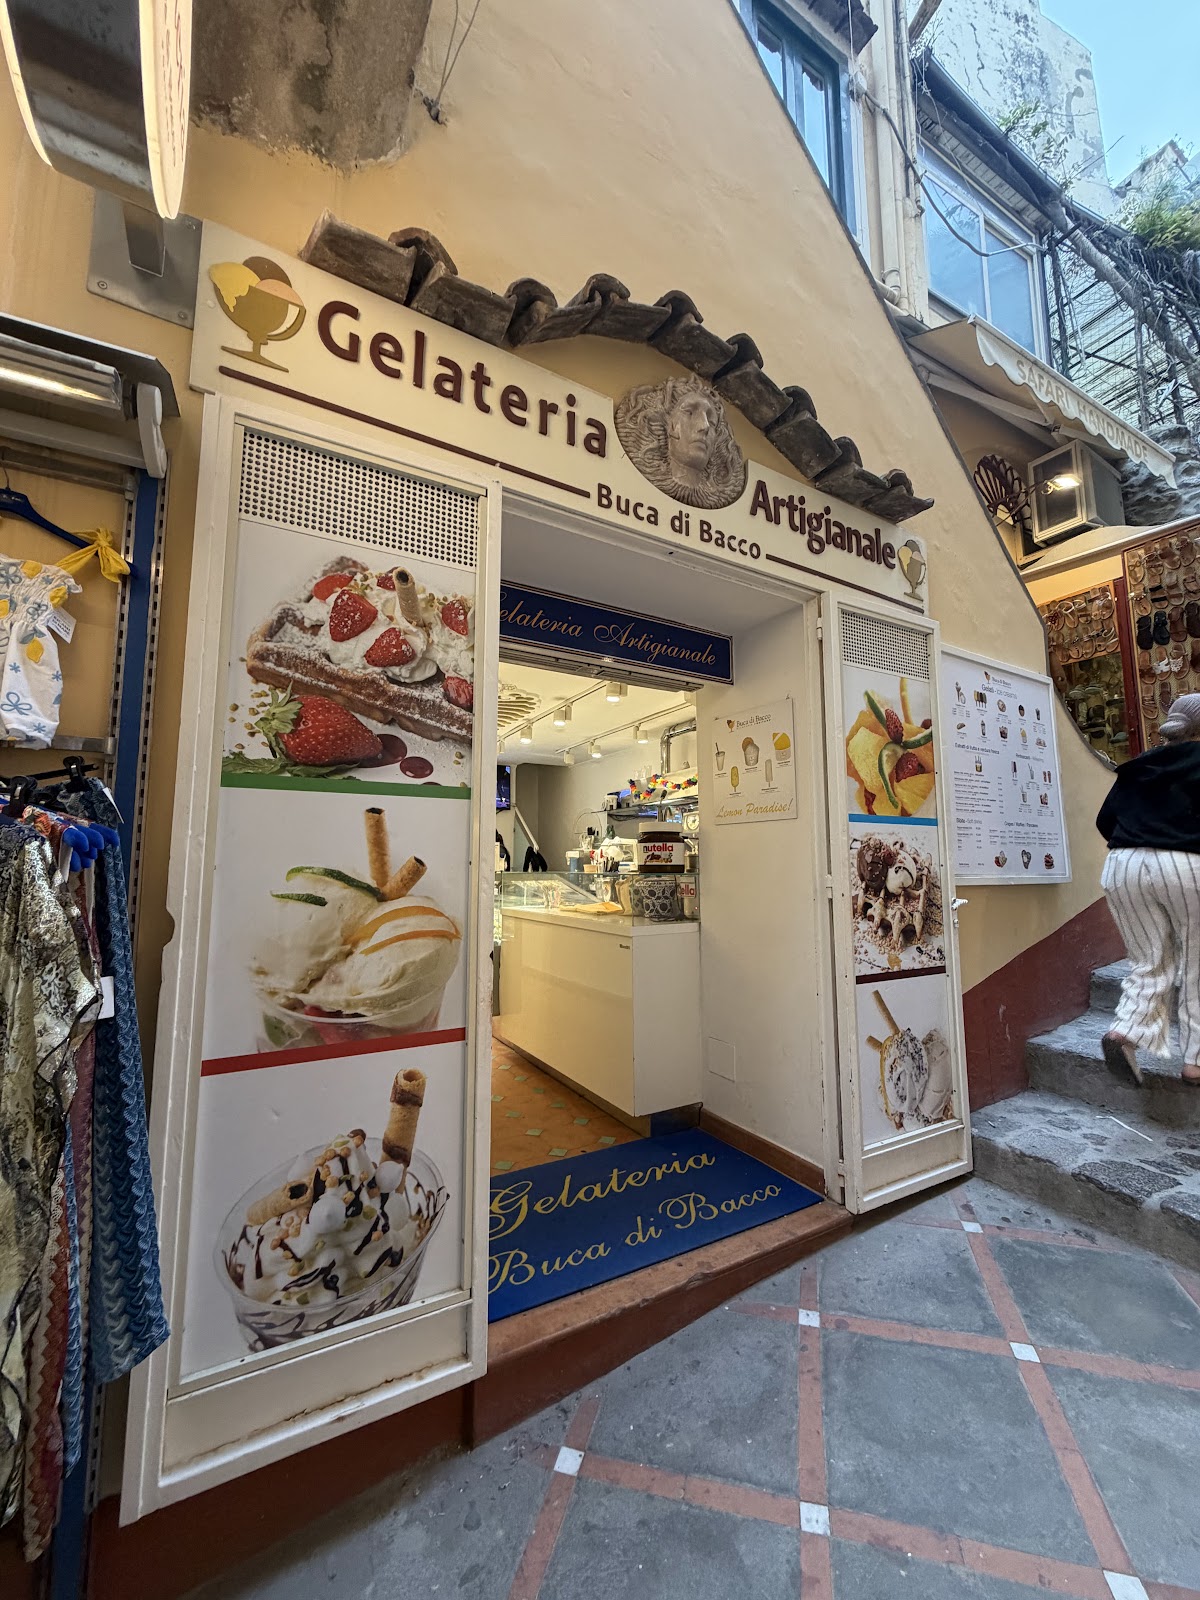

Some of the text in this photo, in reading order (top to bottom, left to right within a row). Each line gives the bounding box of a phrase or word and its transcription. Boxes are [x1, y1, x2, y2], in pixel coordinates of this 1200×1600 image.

[317, 300, 607, 459] Gelateria
[1016, 359, 1150, 462] SAFARI HANDMADE
[597, 483, 761, 559] Buca di Bacco
[750, 479, 896, 569] Artigianale
[500, 592, 716, 665] elateria Artigianale
[643, 843, 673, 853] nutella
[716, 798, 794, 818] Lemon Paradise!
[679, 884, 695, 896] ella
[488, 1152, 716, 1241] Gelateria
[487, 1184, 782, 1294] Buca di Bacco
